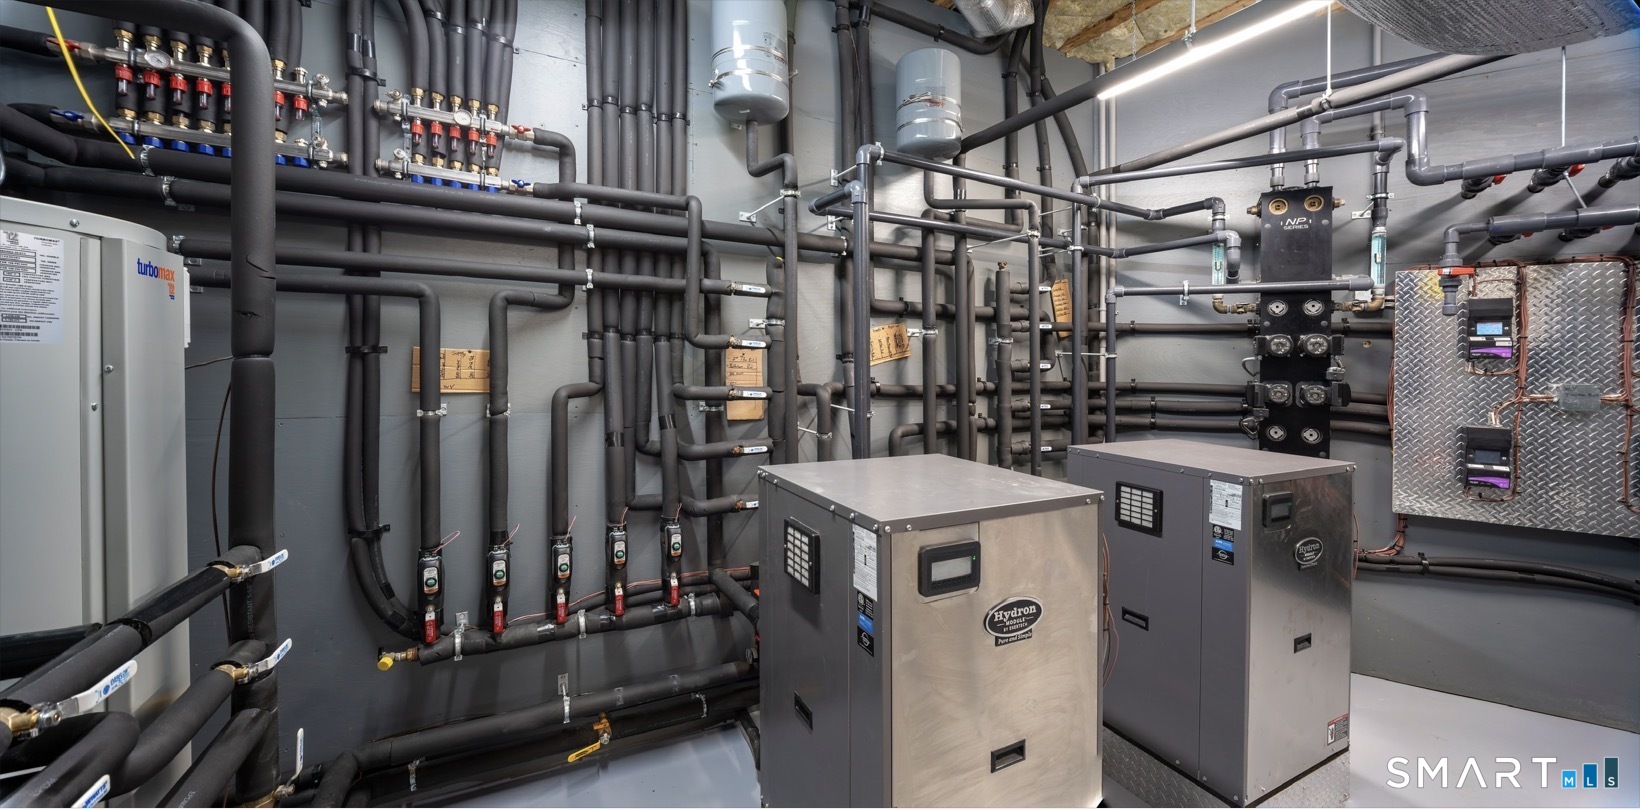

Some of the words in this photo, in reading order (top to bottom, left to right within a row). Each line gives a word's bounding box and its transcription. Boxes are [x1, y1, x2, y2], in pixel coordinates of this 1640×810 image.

[1285, 217, 1307, 226] NP
[137, 258, 175, 282] turbomax
[994, 605, 1036, 621] Hydron
